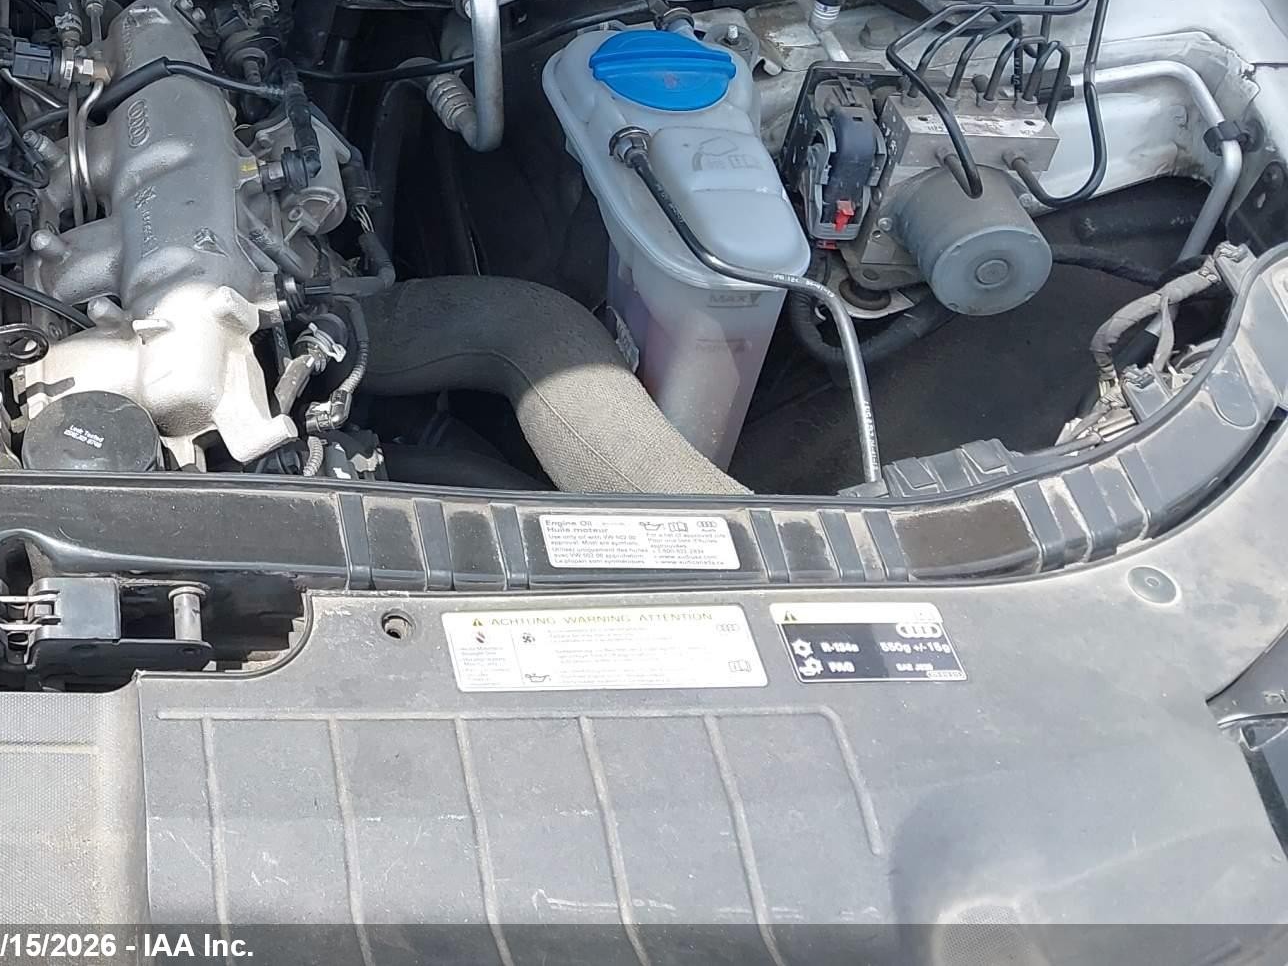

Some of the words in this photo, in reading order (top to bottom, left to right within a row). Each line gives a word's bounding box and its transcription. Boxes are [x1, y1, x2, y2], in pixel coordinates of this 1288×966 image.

[490, 617, 557, 626] ACHTUNG
[562, 615, 632, 624] WARNING
[639, 612, 713, 621] ATTENTION
